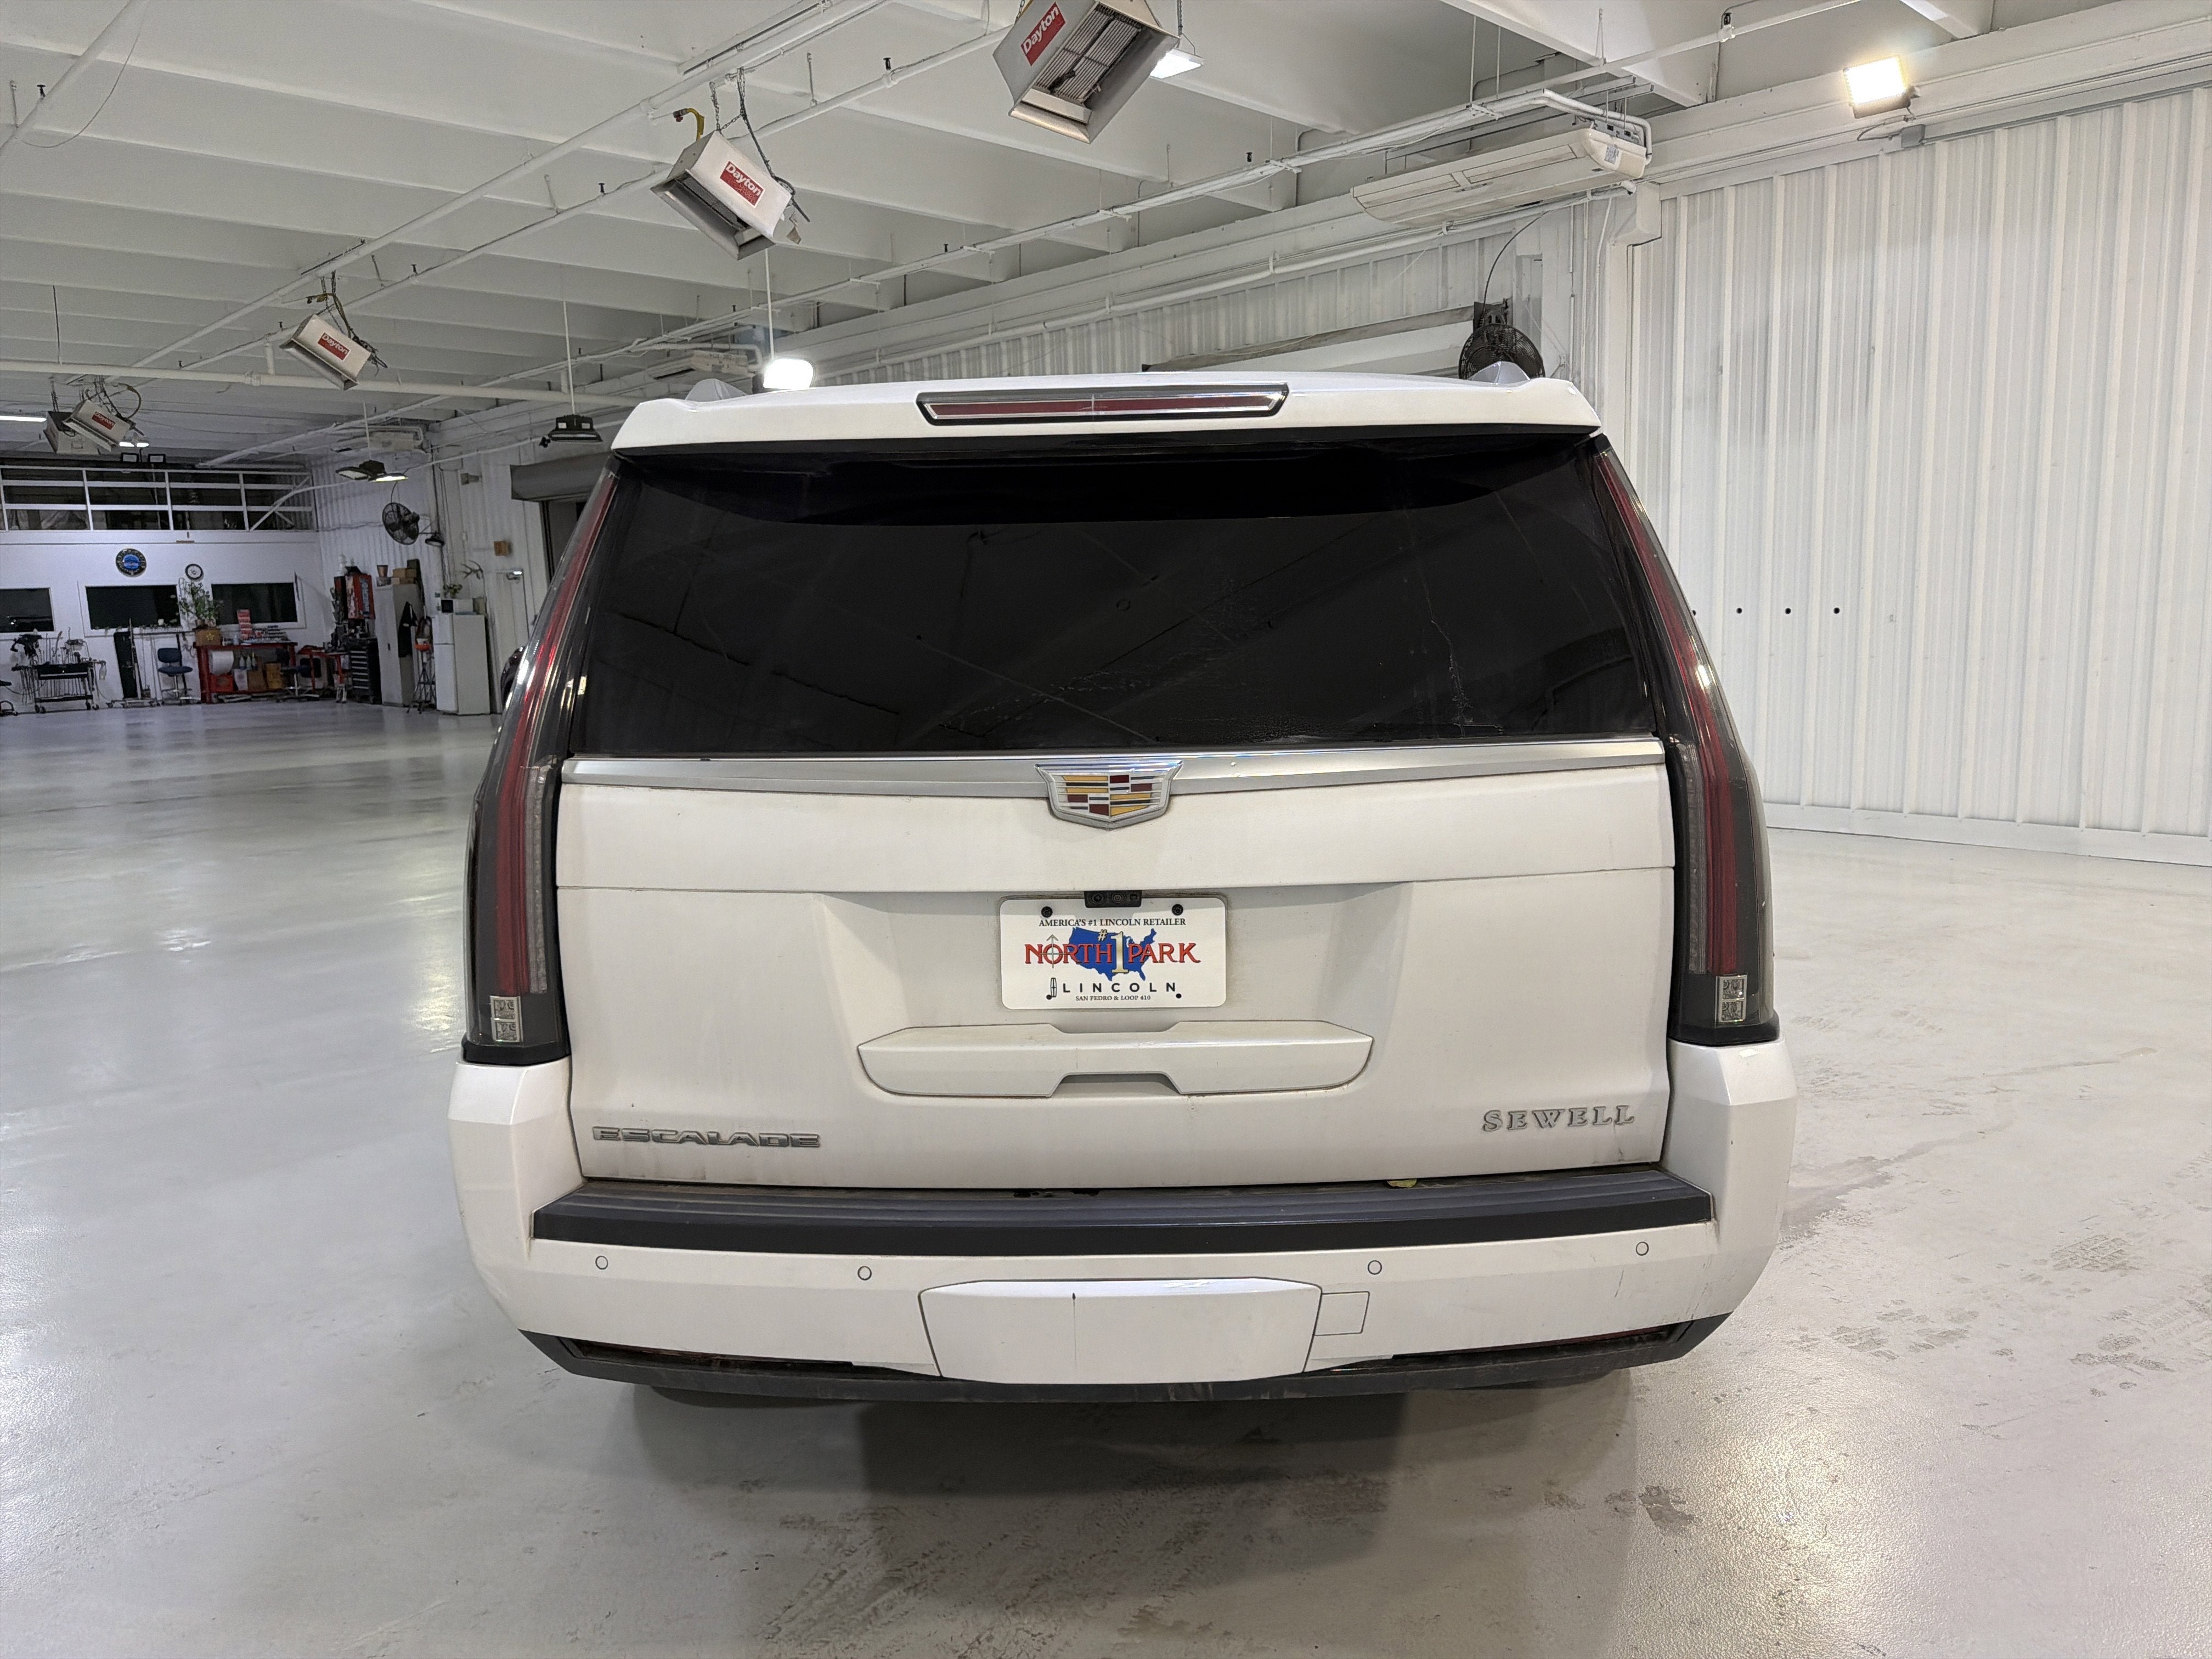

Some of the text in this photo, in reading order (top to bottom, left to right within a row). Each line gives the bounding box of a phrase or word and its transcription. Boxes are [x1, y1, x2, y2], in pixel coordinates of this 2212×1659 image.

[1023, 7, 1059, 54] Dayton
[726, 163, 761, 196] Dayton
[322, 335, 348, 354] Dayton
[94, 412, 115, 426] Dayton
[1025, 943, 1201, 964] NORTH PARK
[1063, 983, 1176, 993] LINCOLN
[1482, 1104, 1635, 1132] SEWELL
[592, 1126, 821, 1148] ESCALADE
